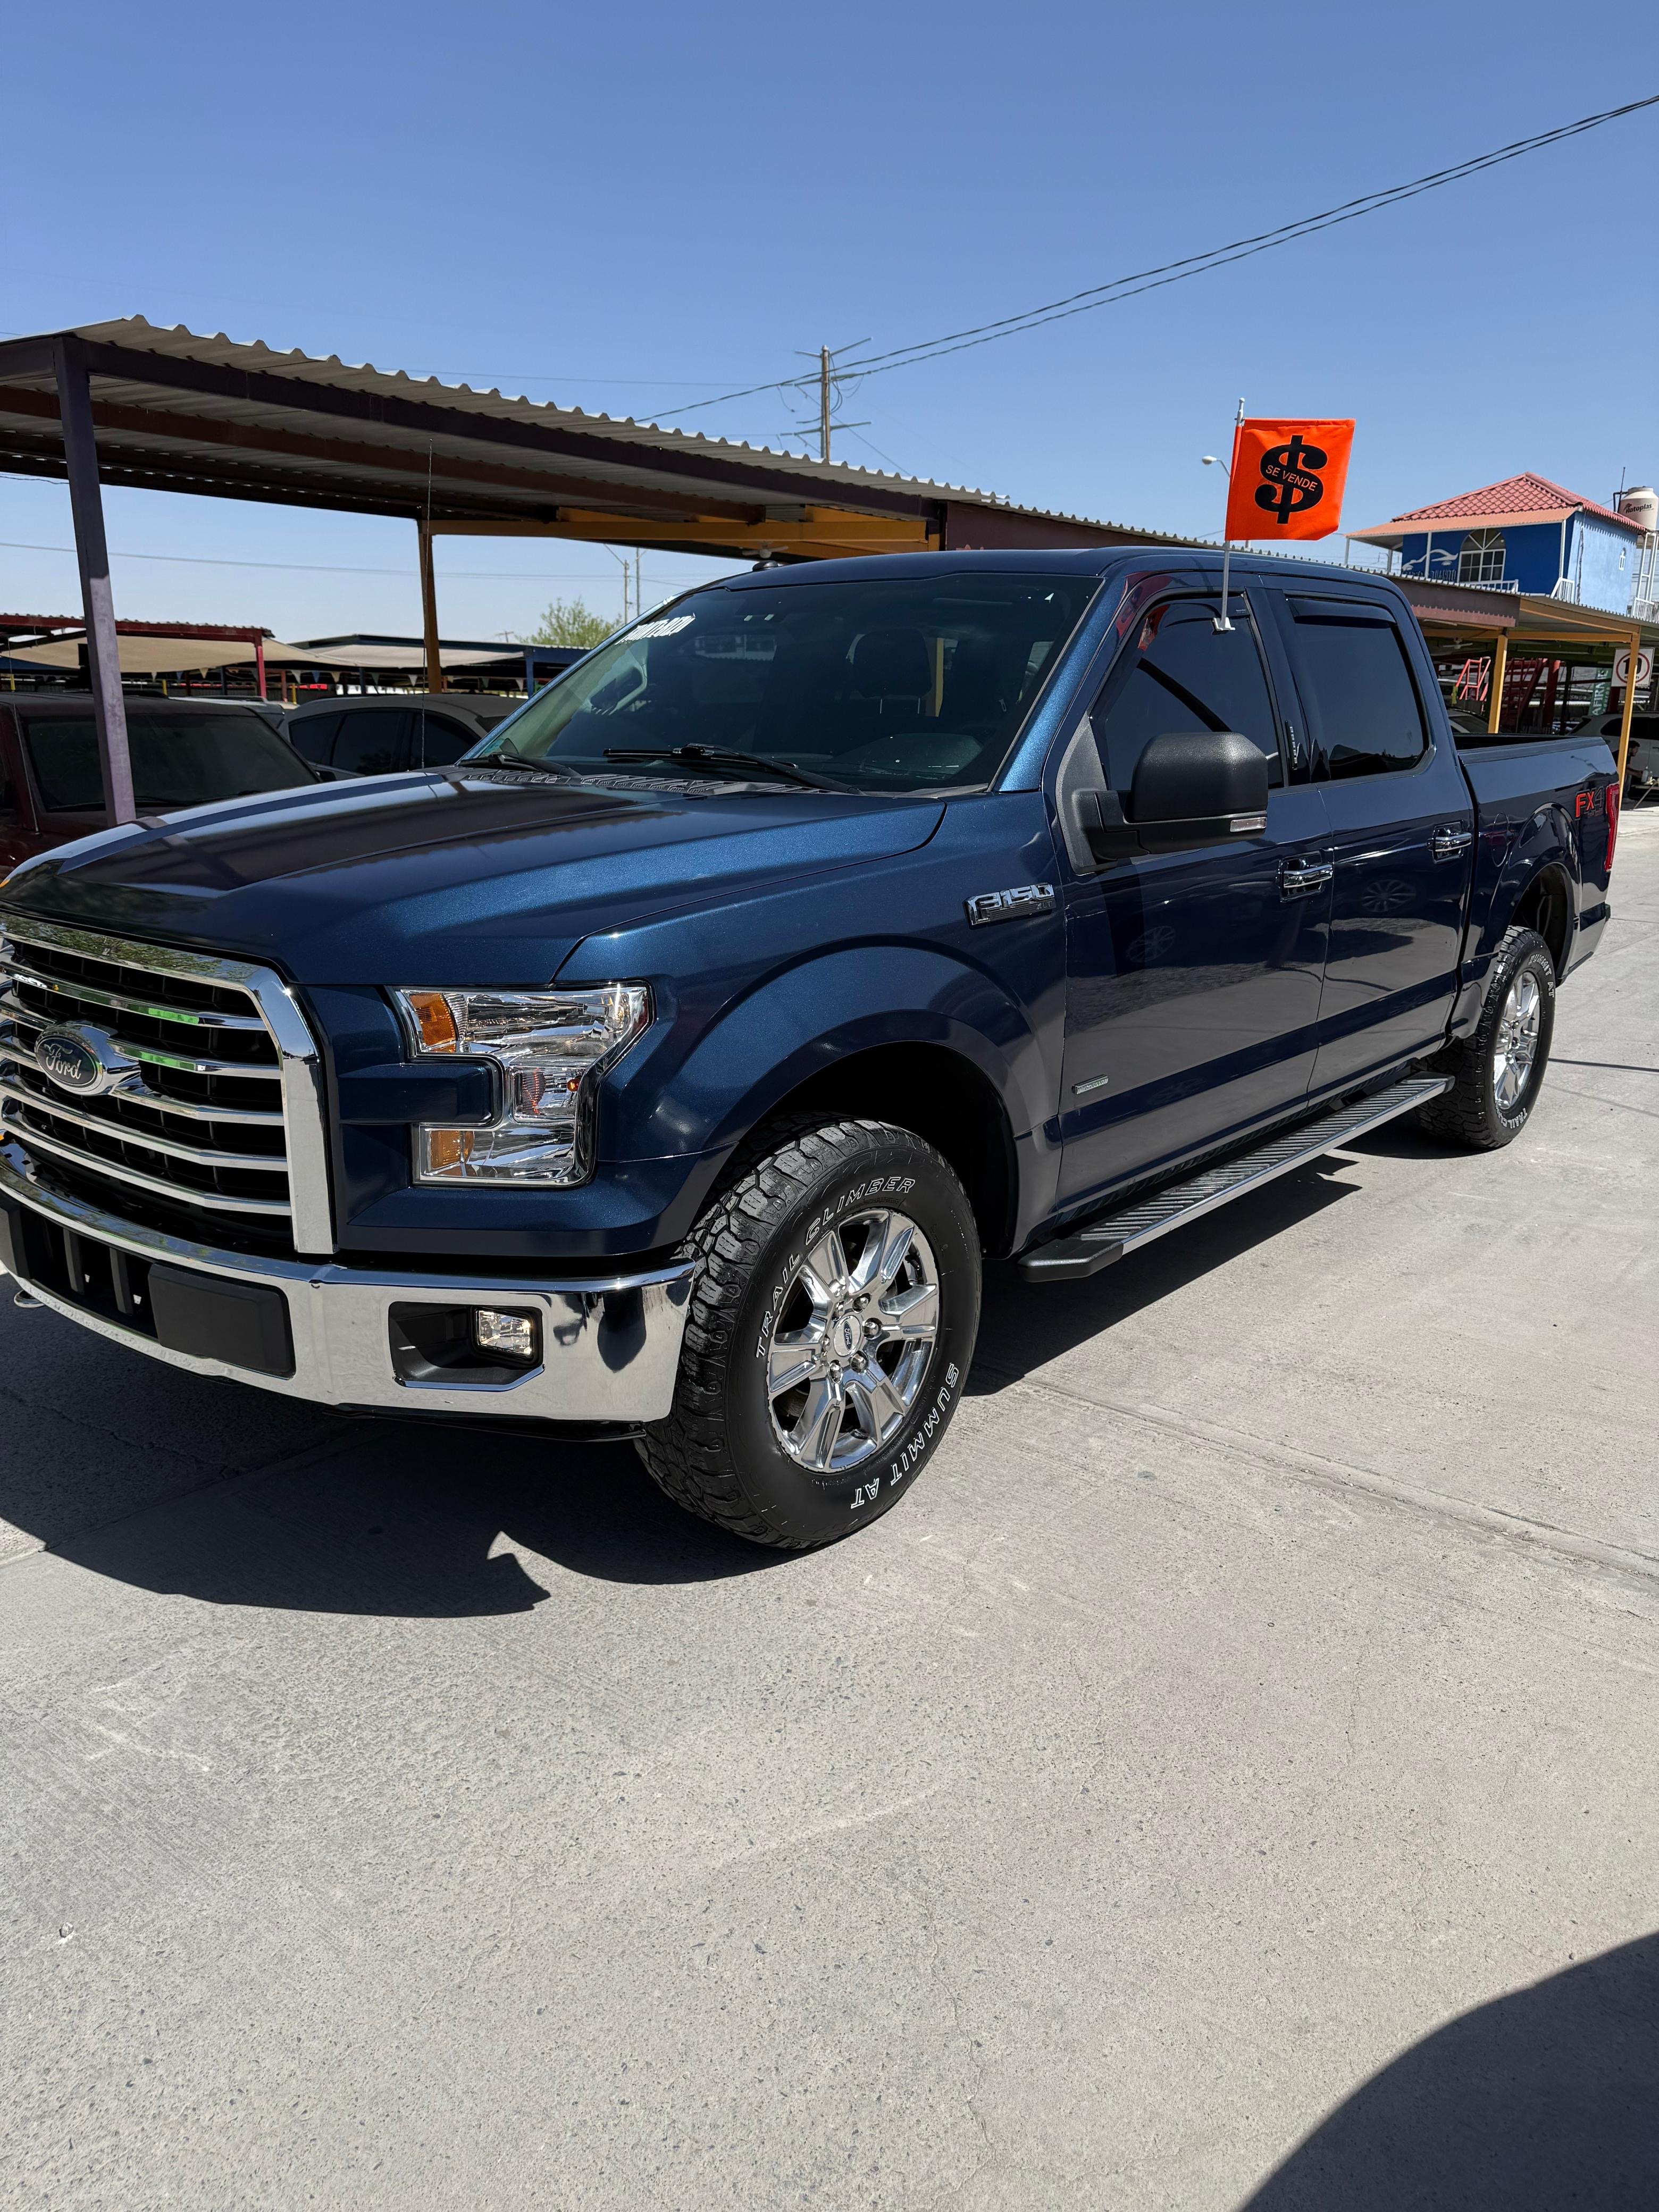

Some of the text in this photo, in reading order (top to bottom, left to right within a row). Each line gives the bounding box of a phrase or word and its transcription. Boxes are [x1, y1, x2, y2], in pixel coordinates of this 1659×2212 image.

[1266, 465, 1318, 491] SE VENDE
[1575, 786, 1604, 820] FX4
[1528, 953, 1555, 998] SUMMIT AT
[44, 1043, 82, 1080] Ford
[756, 1253, 800, 1359] TRAIL
[805, 1176, 916, 1246] CLIMBER
[890, 1362, 959, 1486] SUMMIT
[850, 1478, 880, 1509] AT
